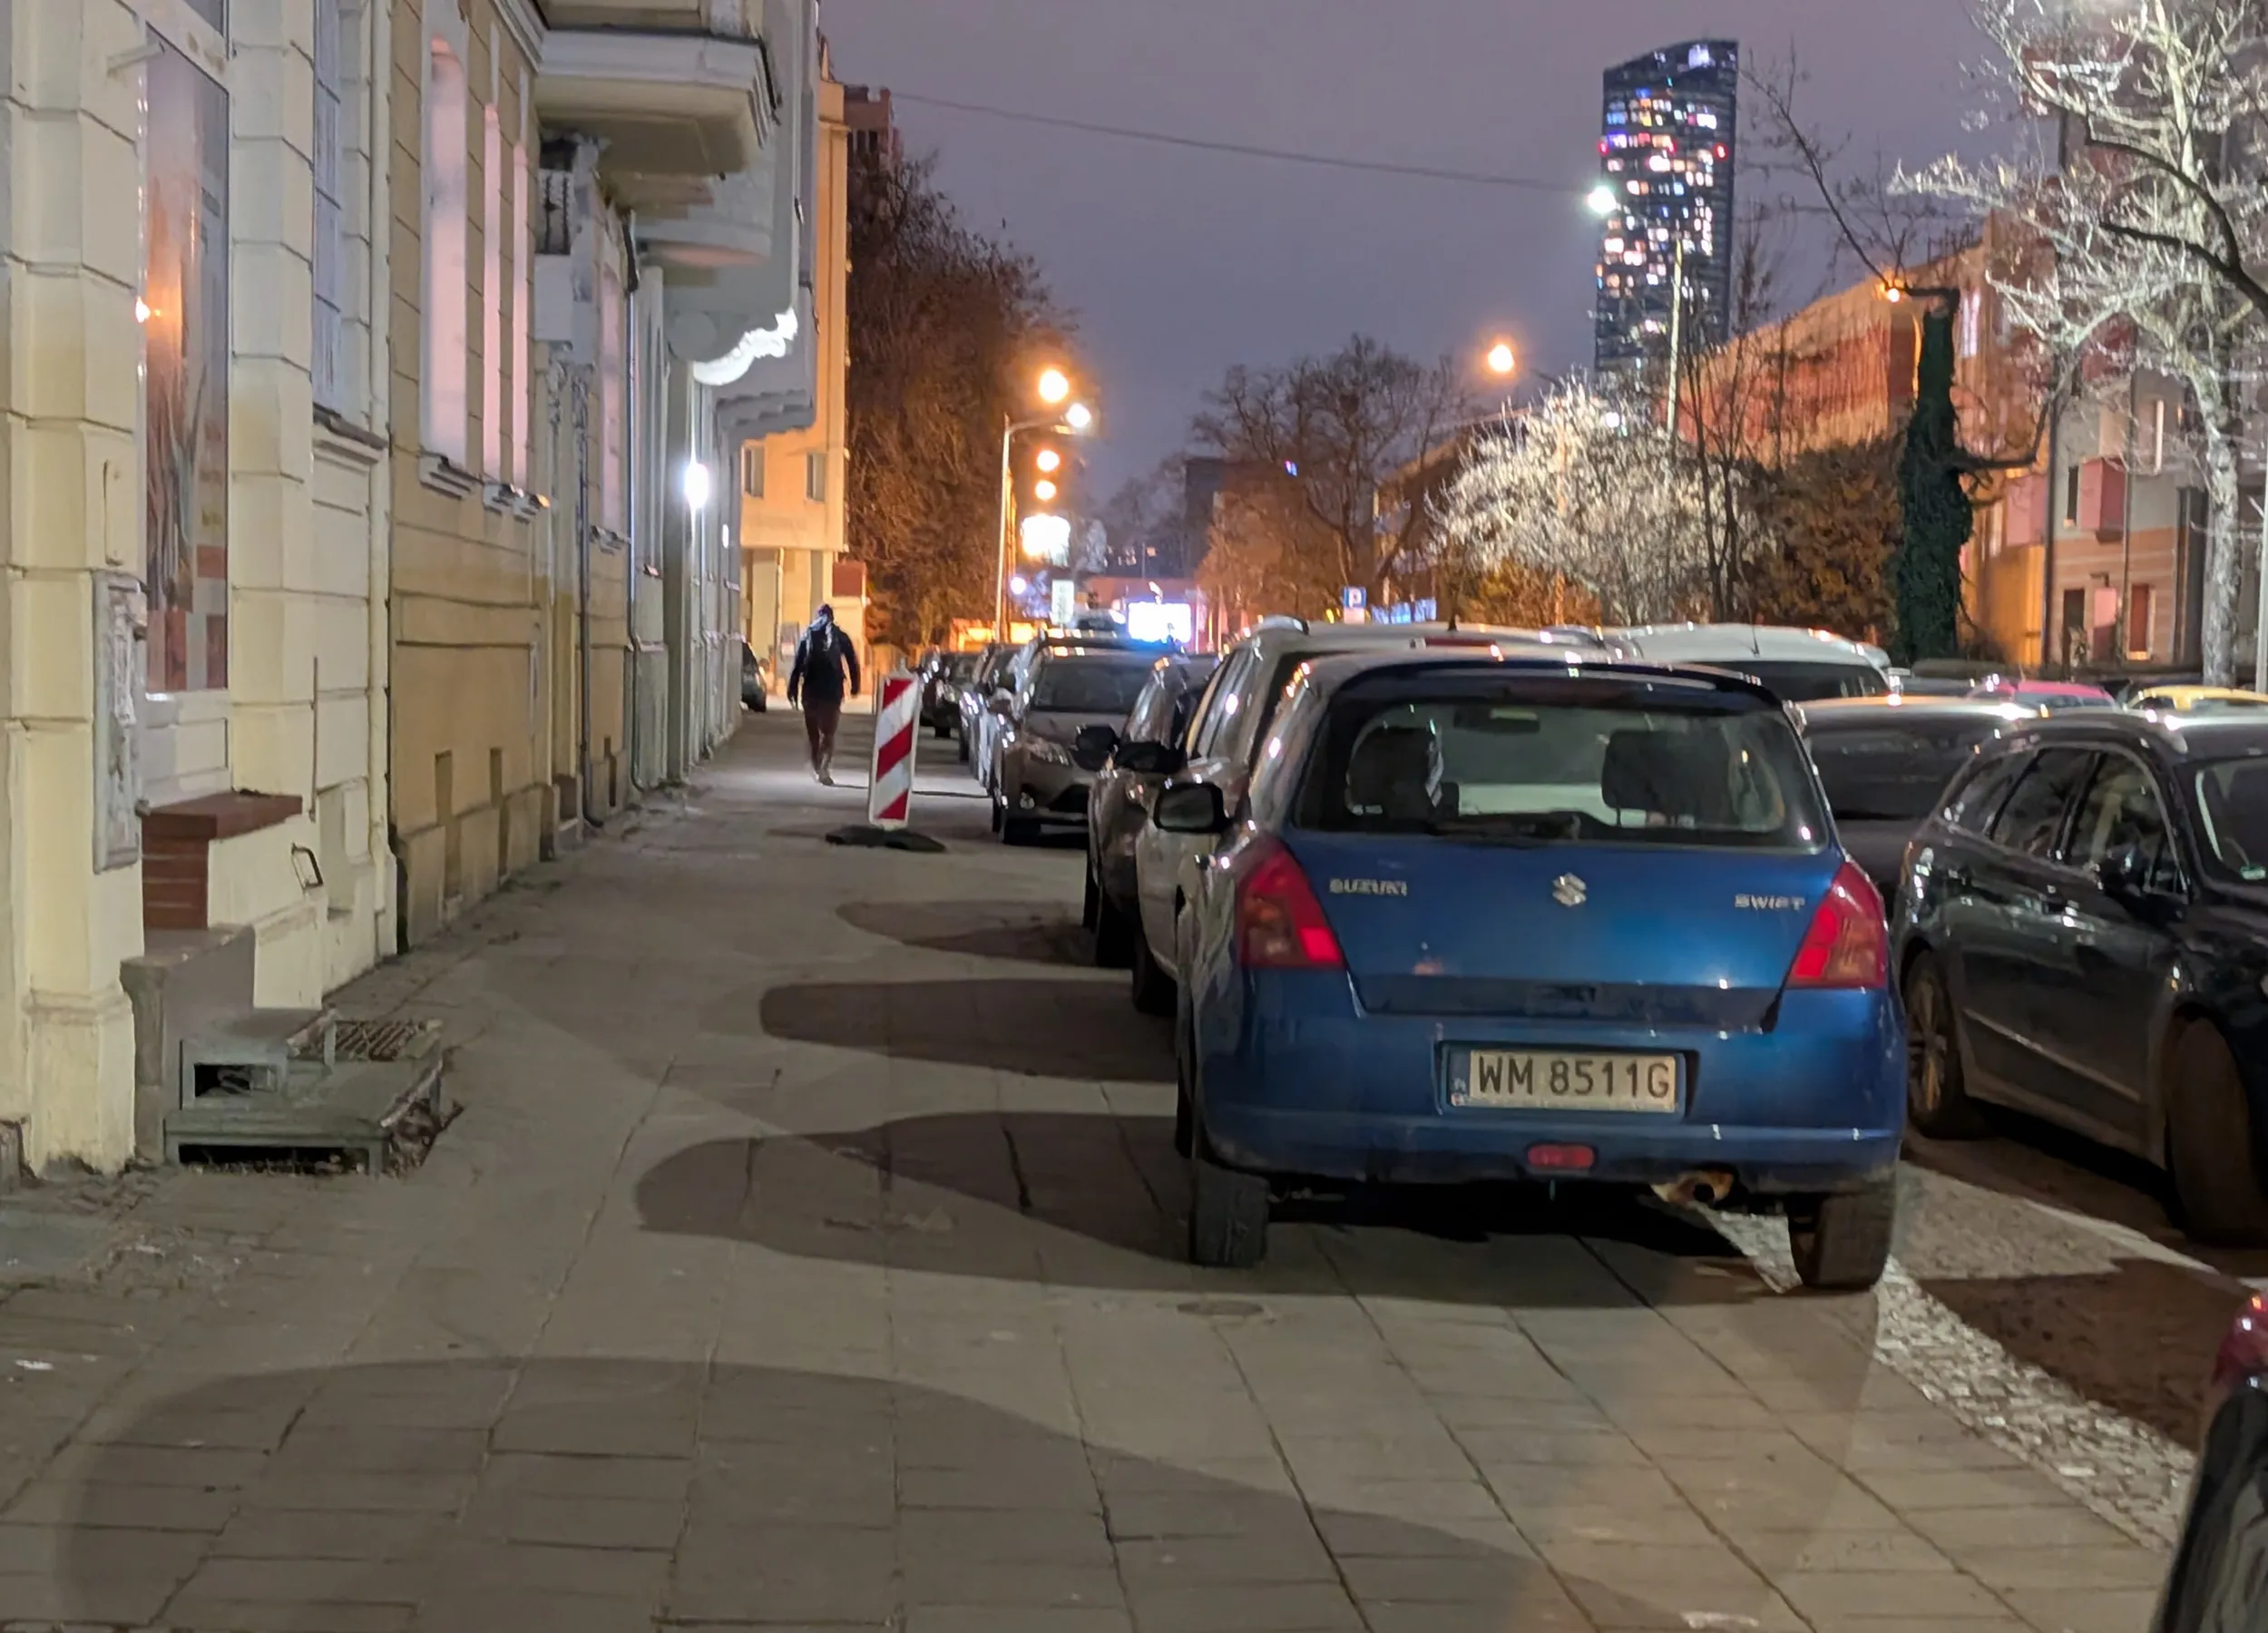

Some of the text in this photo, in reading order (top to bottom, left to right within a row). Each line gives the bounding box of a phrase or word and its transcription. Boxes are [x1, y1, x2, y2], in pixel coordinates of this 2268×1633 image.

[1348, 587, 1363, 608] P
[1329, 877, 1408, 896] SUZUKI
[1478, 1055, 1670, 1100] WM 8511G
